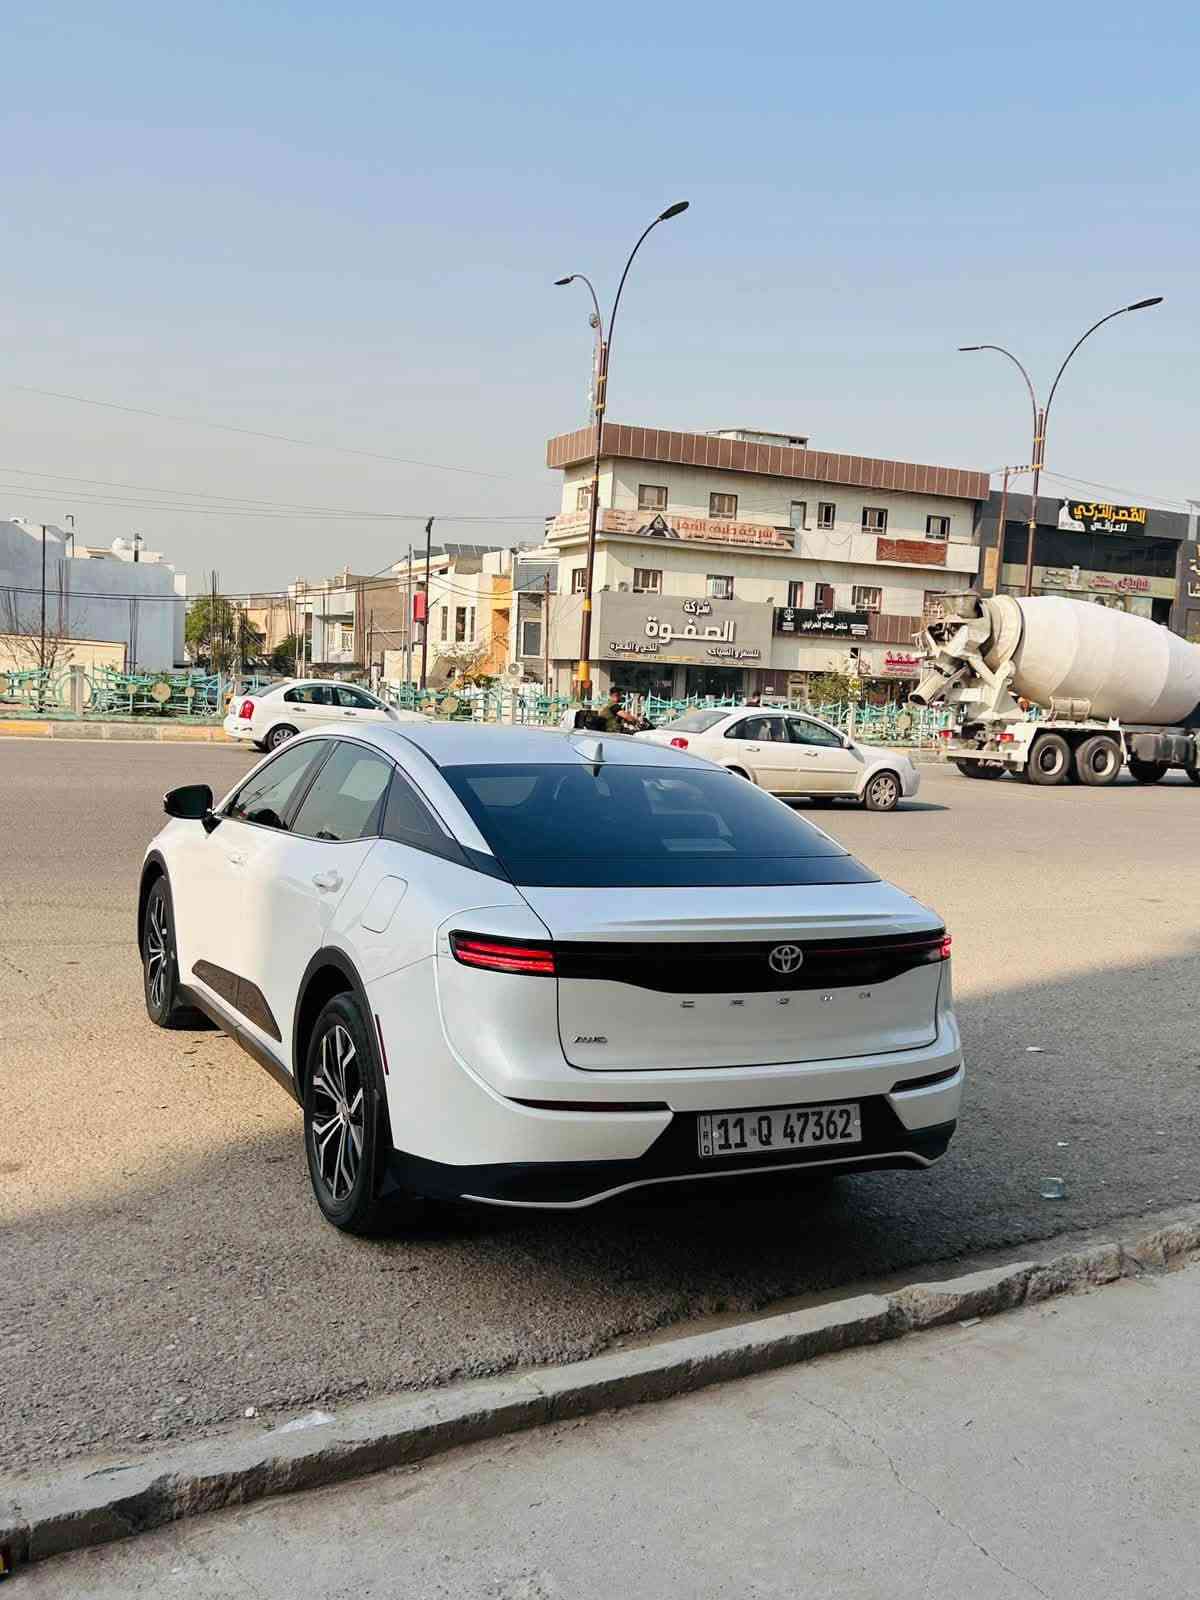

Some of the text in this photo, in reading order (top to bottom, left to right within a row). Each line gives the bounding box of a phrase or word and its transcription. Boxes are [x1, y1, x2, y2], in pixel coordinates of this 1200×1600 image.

[1073, 502, 1146, 525] القصر التركي
[683, 600, 711, 615] شركة
[645, 616, 735, 644] الصفوة
[717, 1108, 853, 1150] 11 Q 47362
